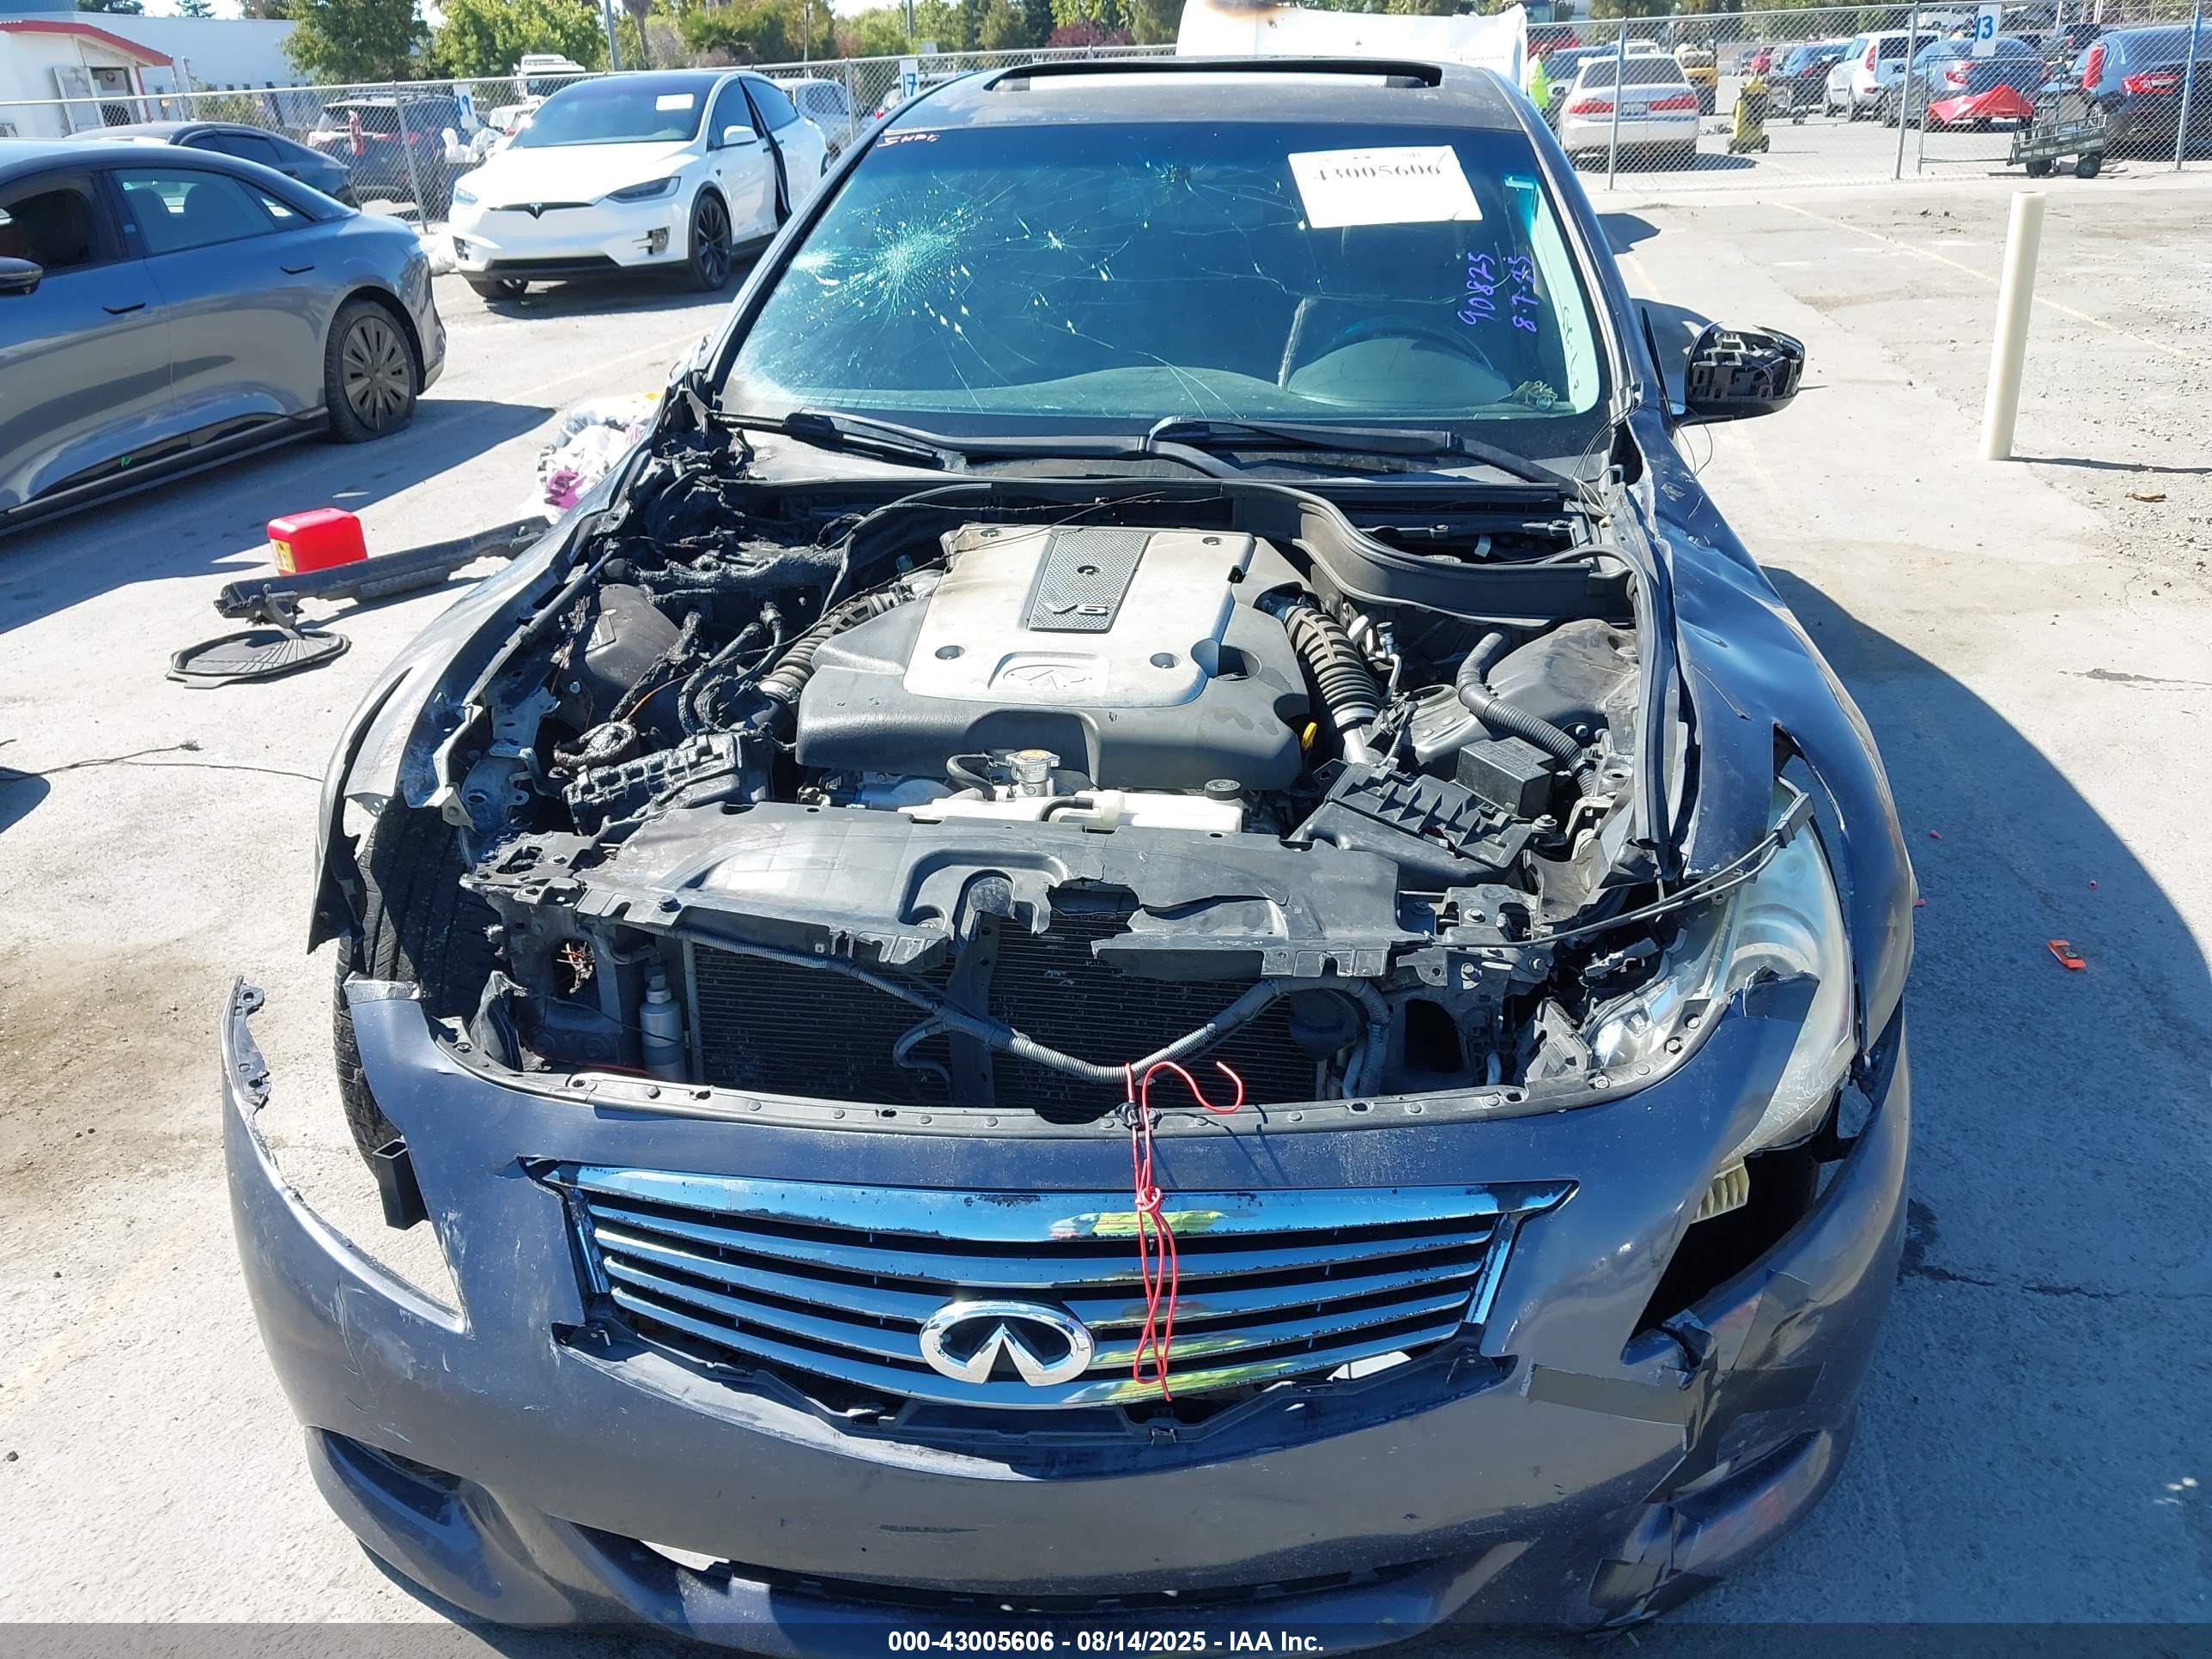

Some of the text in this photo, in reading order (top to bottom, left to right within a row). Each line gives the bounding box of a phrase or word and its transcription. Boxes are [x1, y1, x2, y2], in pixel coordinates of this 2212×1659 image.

[1974, 15, 1994, 43] 13
[902, 72, 918, 97] 17
[1042, 602, 1110, 617] V6
